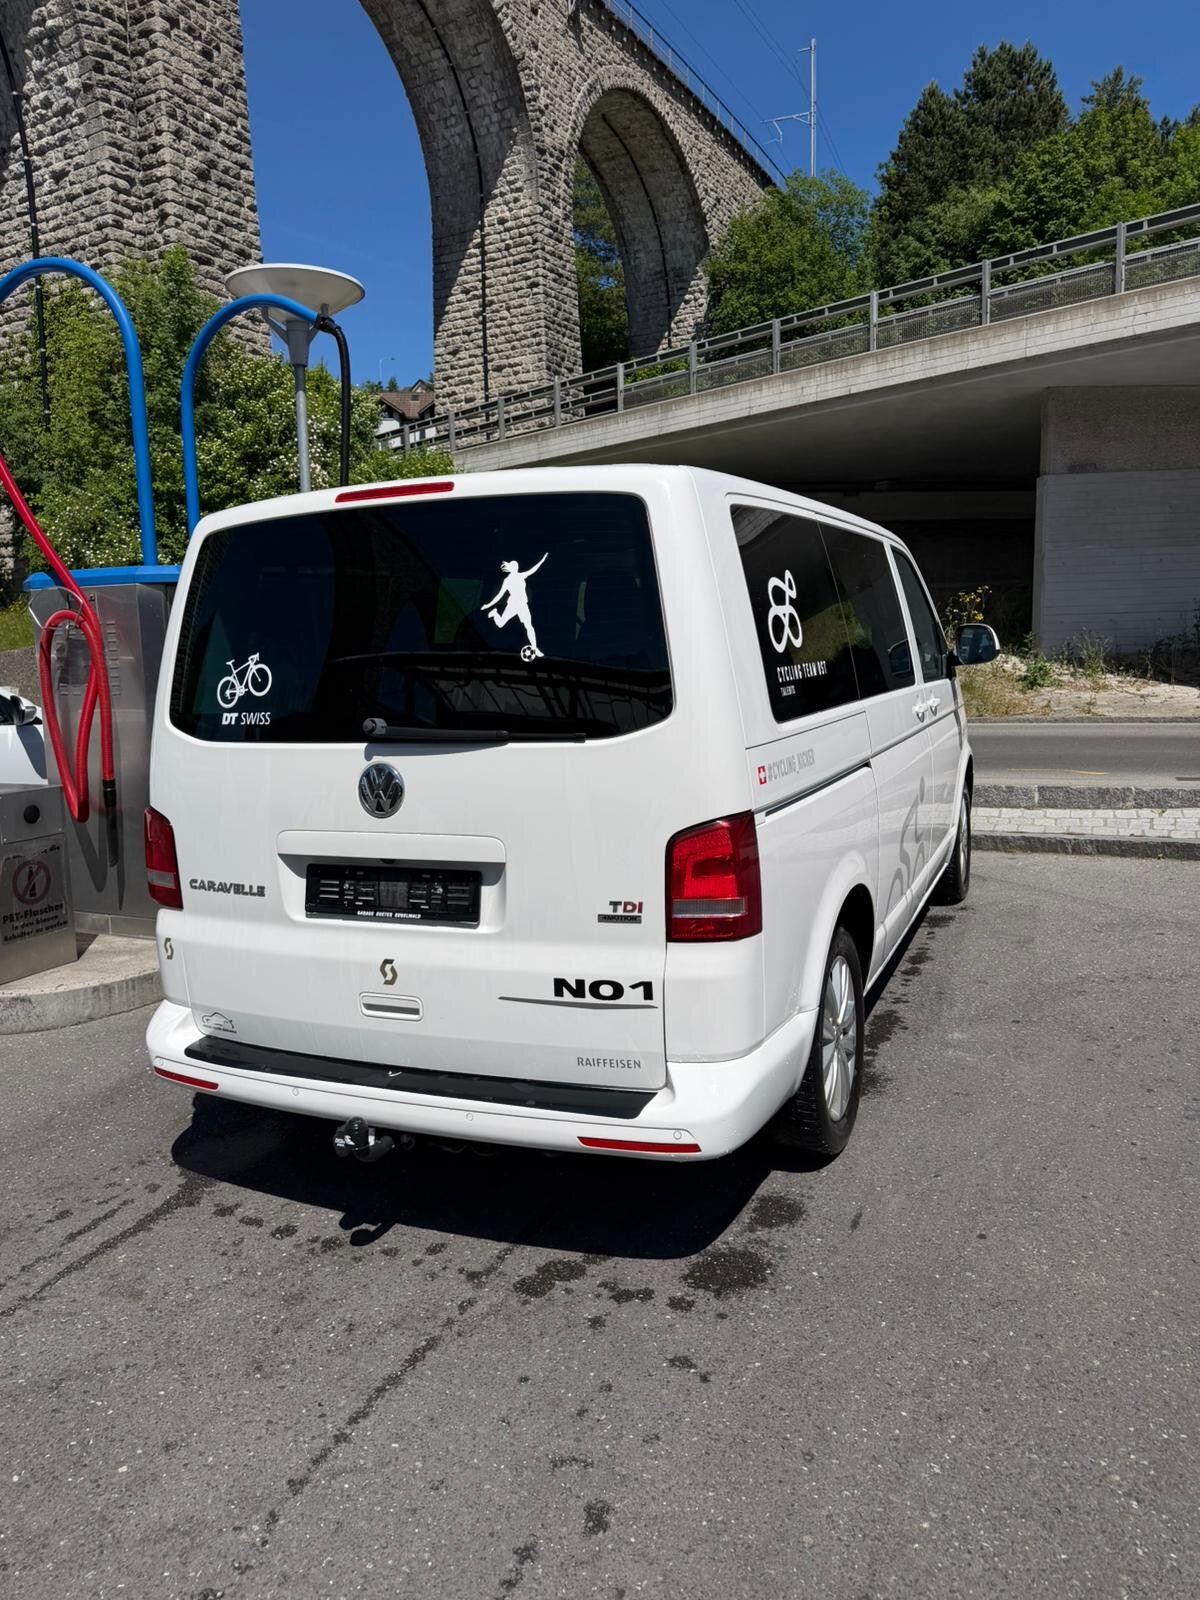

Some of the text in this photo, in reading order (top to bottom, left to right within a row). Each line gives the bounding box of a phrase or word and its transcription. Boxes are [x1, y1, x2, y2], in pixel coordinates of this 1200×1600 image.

[776, 664, 803, 683] CYCLING
[802, 662, 818, 679] TEAM
[221, 712, 271, 725] DT SWISS
[189, 878, 266, 897] CARAVELLE
[609, 901, 643, 914] TDI
[553, 977, 654, 1001] NO1
[576, 1056, 642, 1069] RAIFFEISEN
